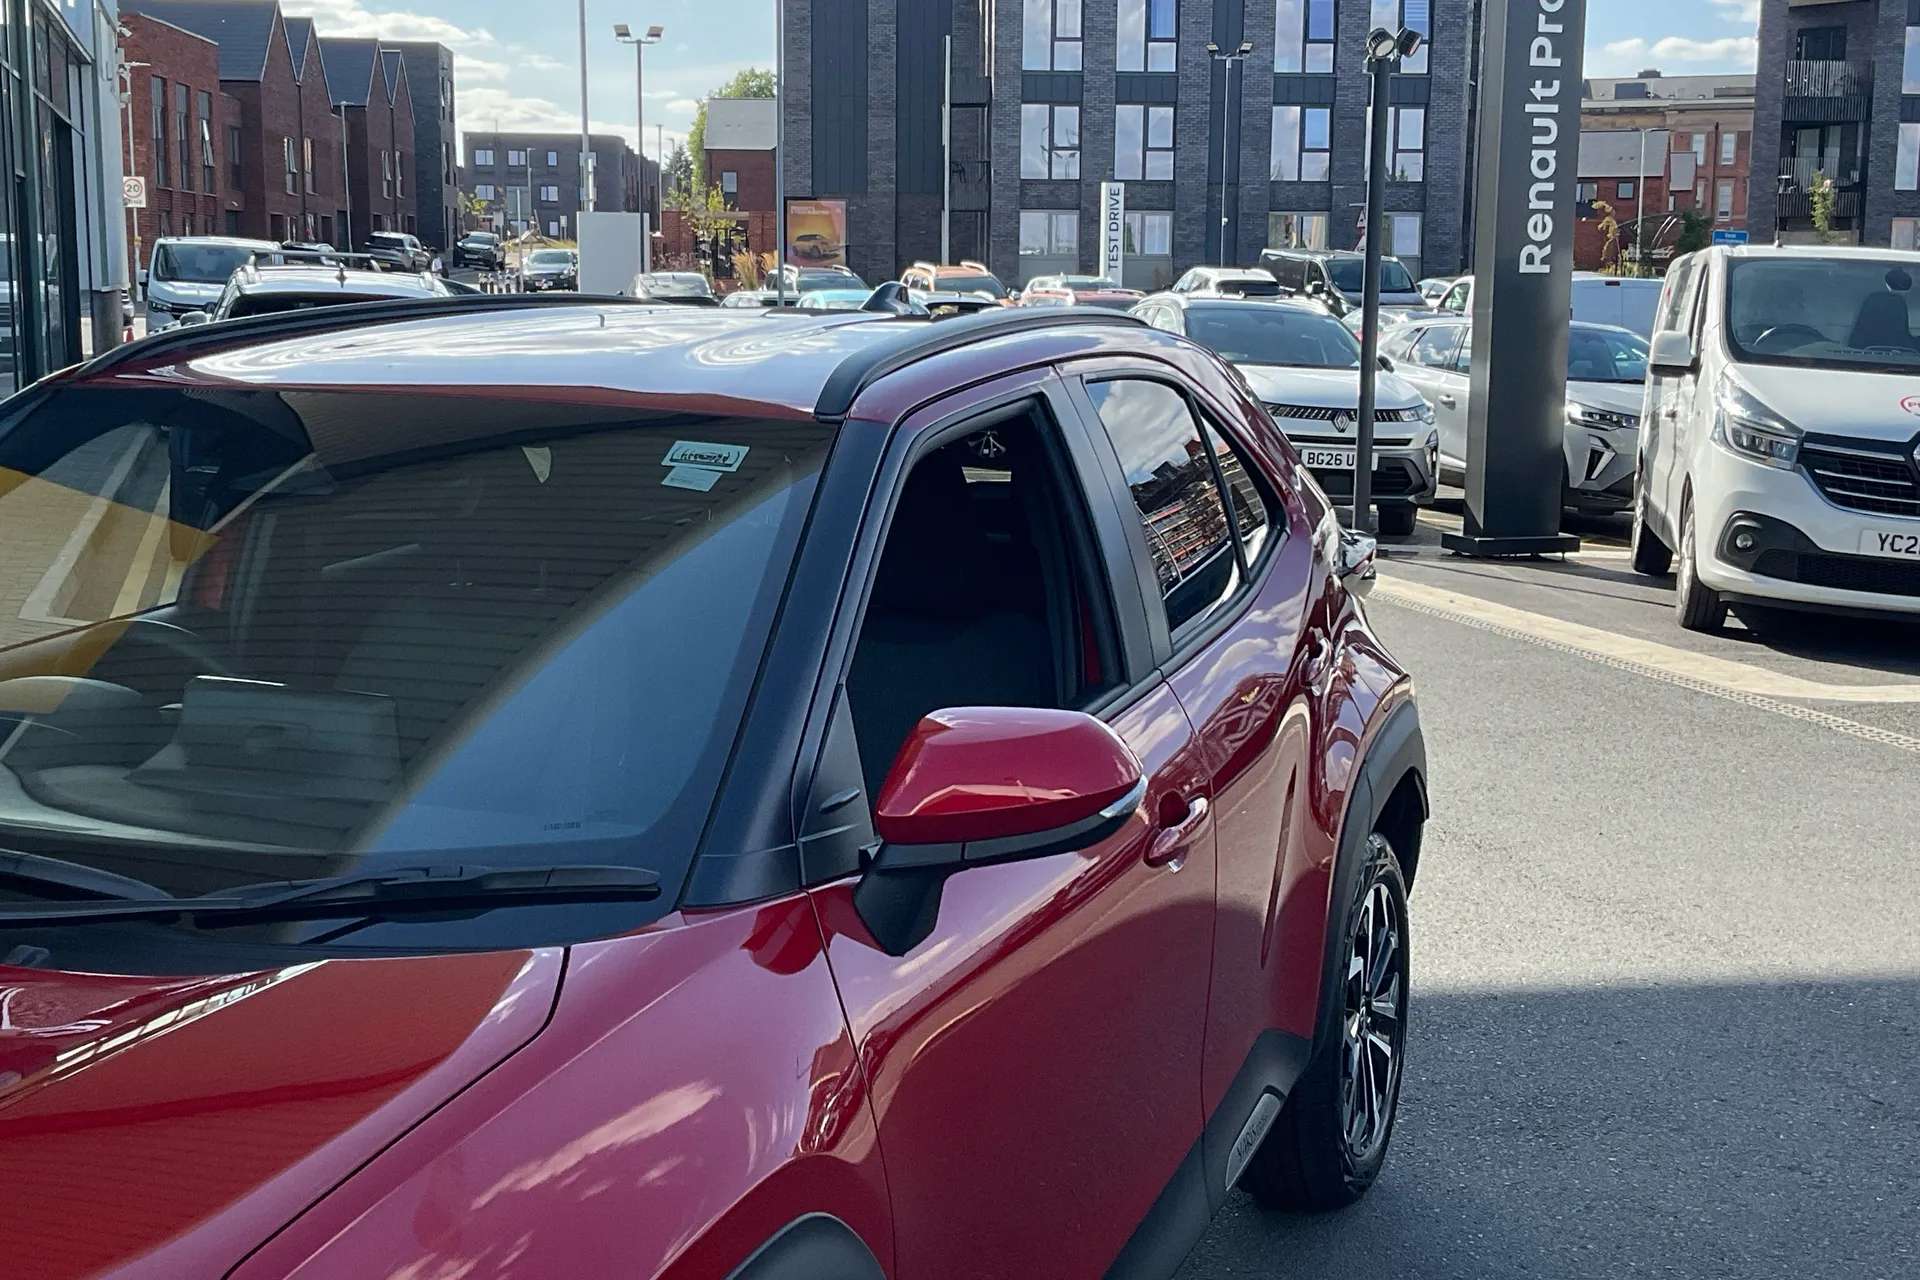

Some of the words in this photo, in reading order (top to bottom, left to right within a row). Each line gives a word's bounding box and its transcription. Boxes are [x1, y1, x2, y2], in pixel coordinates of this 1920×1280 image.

[126, 184, 139, 193] 20
[1519, 79, 1561, 274] Renault
[1109, 187, 1120, 232] DRIVE
[1108, 235, 1119, 272] TEST
[1307, 452, 1342, 466] BG26
[1878, 533, 1920, 554] YC2
